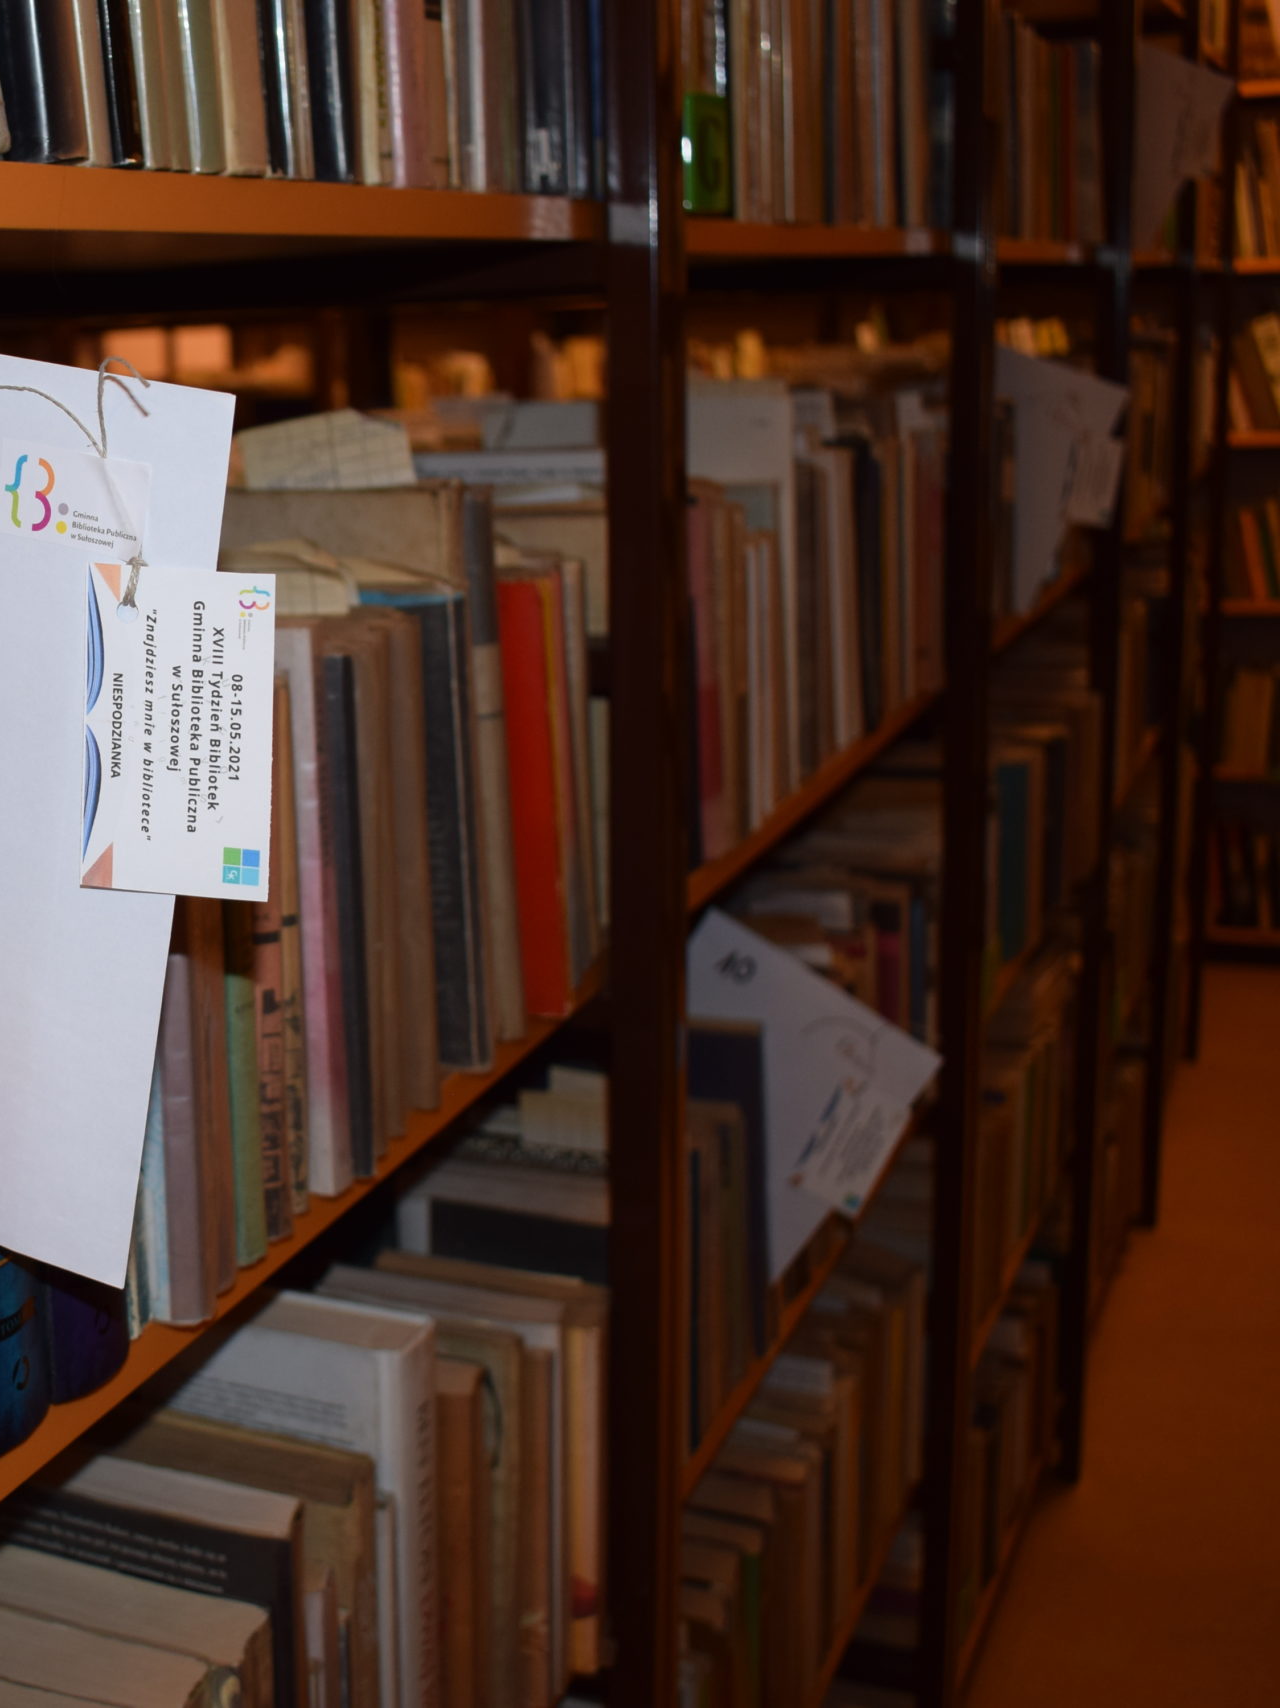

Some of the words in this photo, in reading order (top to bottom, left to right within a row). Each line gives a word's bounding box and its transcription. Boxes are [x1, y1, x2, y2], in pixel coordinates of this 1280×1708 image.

[72, 521, 105, 535] Biblioteka
[106, 529, 137, 542] Publiczna
[73, 510, 99, 522] Gminna
[192, 600, 205, 663] Gminna
[212, 627, 224, 665] XVIII
[172, 665, 182, 678] w
[209, 671, 223, 732] Tydzień
[111, 673, 123, 779] NIESPODZIANKA
[144, 700, 155, 736] mnie
[166, 683, 183, 772] Sułoszowej
[190, 669, 204, 751] Biblioteka
[228, 674, 243, 781] 08-15.05.2021
[143, 742, 153, 754] w
[208, 739, 221, 811] Bibliotek
[187, 757, 201, 833] Publiczna
